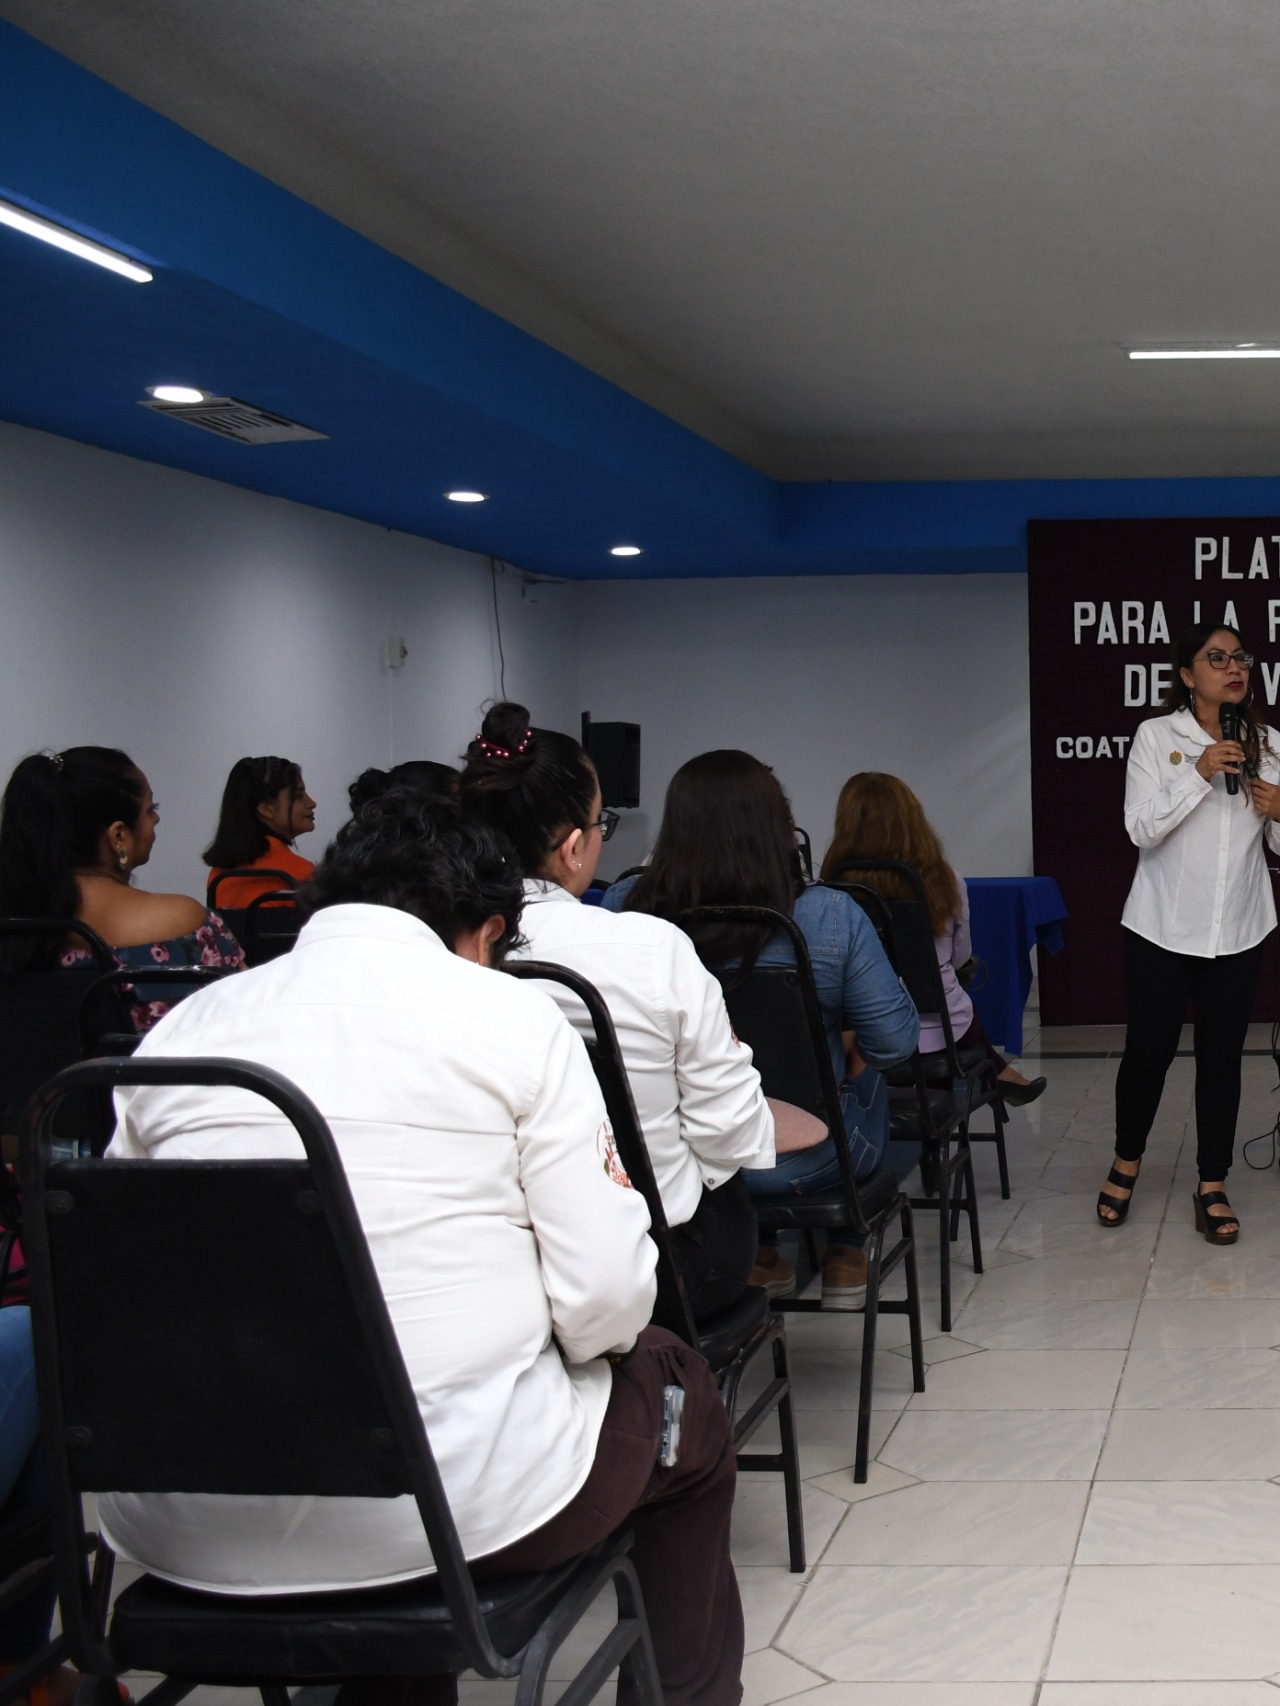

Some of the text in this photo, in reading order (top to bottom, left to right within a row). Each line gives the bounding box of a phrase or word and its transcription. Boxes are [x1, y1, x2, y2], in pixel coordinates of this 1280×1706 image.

[1074, 601, 1171, 645] PARA
[1124, 663, 1172, 707] DE
[1056, 736, 1135, 759] COAT
